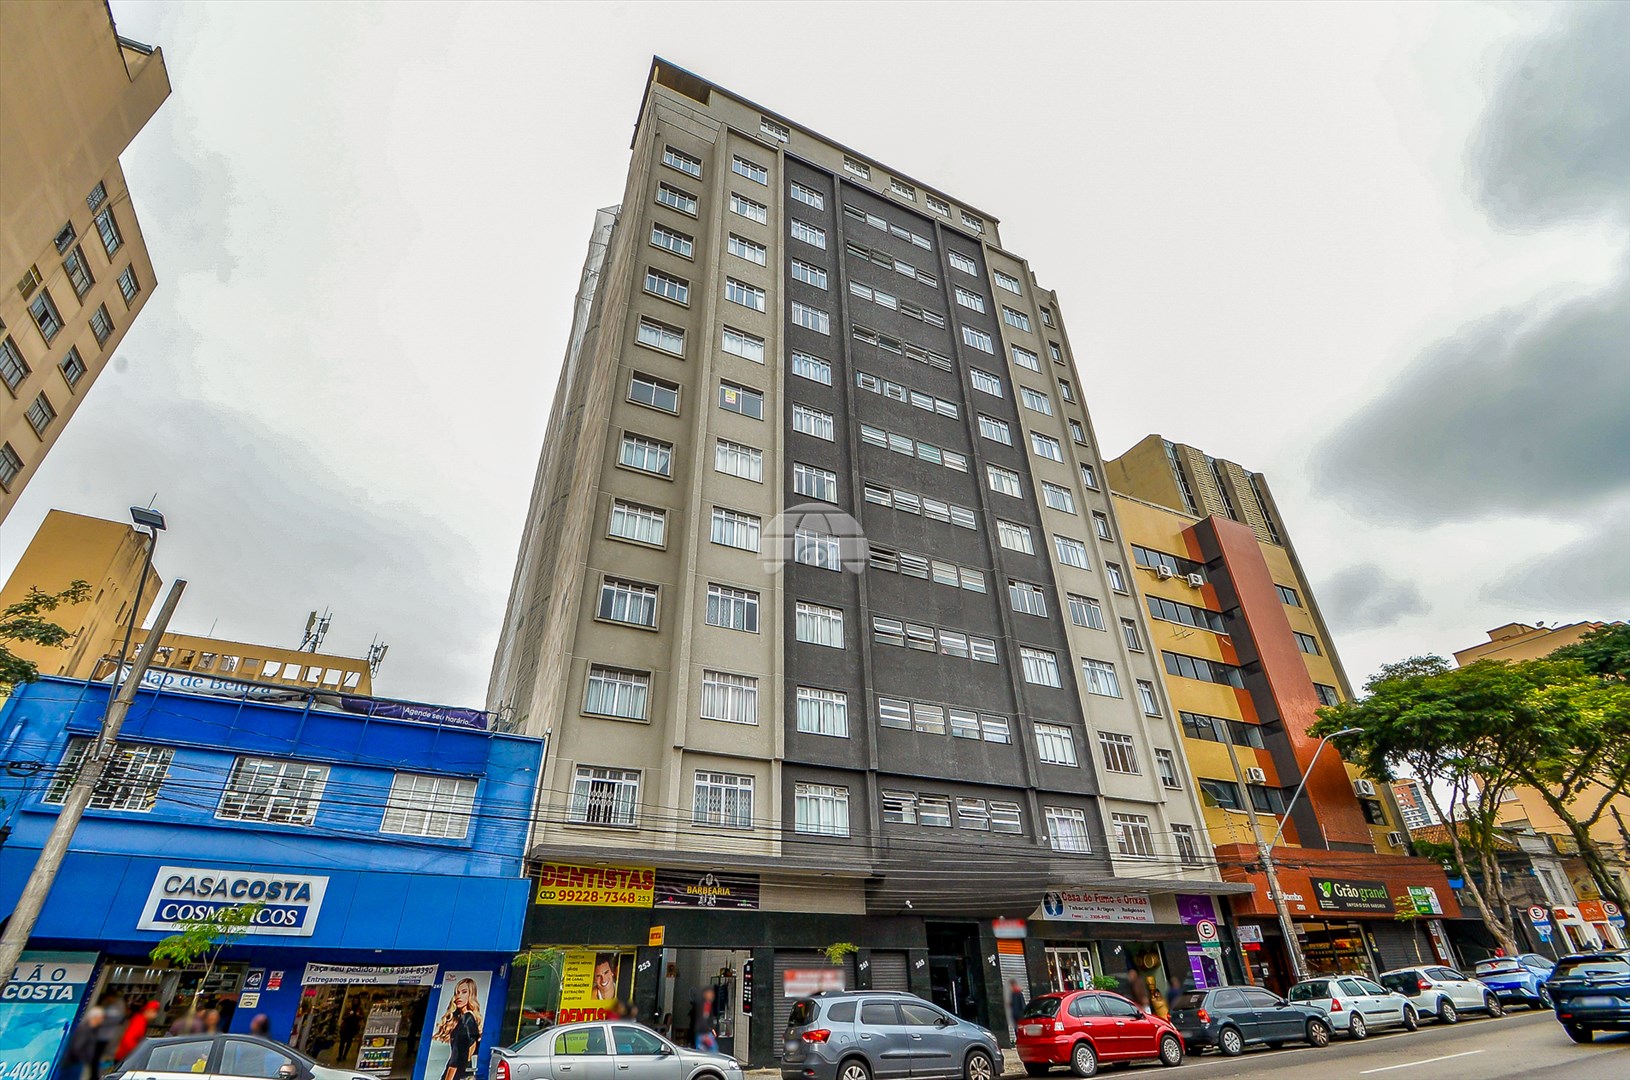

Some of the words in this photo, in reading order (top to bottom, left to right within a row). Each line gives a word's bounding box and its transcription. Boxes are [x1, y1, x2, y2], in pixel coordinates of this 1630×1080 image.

[180, 677, 204, 687] de
[209, 676, 271, 694] Beleza
[404, 706, 432, 718] Agende
[432, 712, 444, 721] seu
[541, 865, 655, 891] DENTISTAS
[163, 875, 312, 901] CASACOSTA
[687, 885, 731, 896] BARBEARIA
[1333, 883, 1359, 898] Grão
[1359, 885, 1388, 902] granel
[558, 889, 636, 903] 99228-7348
[1062, 892, 1081, 902] Casa
[1083, 893, 1092, 902] do
[1095, 893, 1114, 904] Fumo
[1097, 905, 1115, 913] Artigos
[1121, 906, 1146, 914] Religiosos
[1532, 908, 1541, 917] E
[1606, 905, 1614, 913] E
[1202, 924, 1211, 935] E
[309, 964, 329, 973] Faça
[330, 965, 344, 973] seu
[346, 966, 373, 974] pedido
[638, 961, 651, 971] 253
[859, 960, 869, 971] 261
[306, 975, 347, 984] Entregamos
[2, 984, 74, 1000] COSTA
